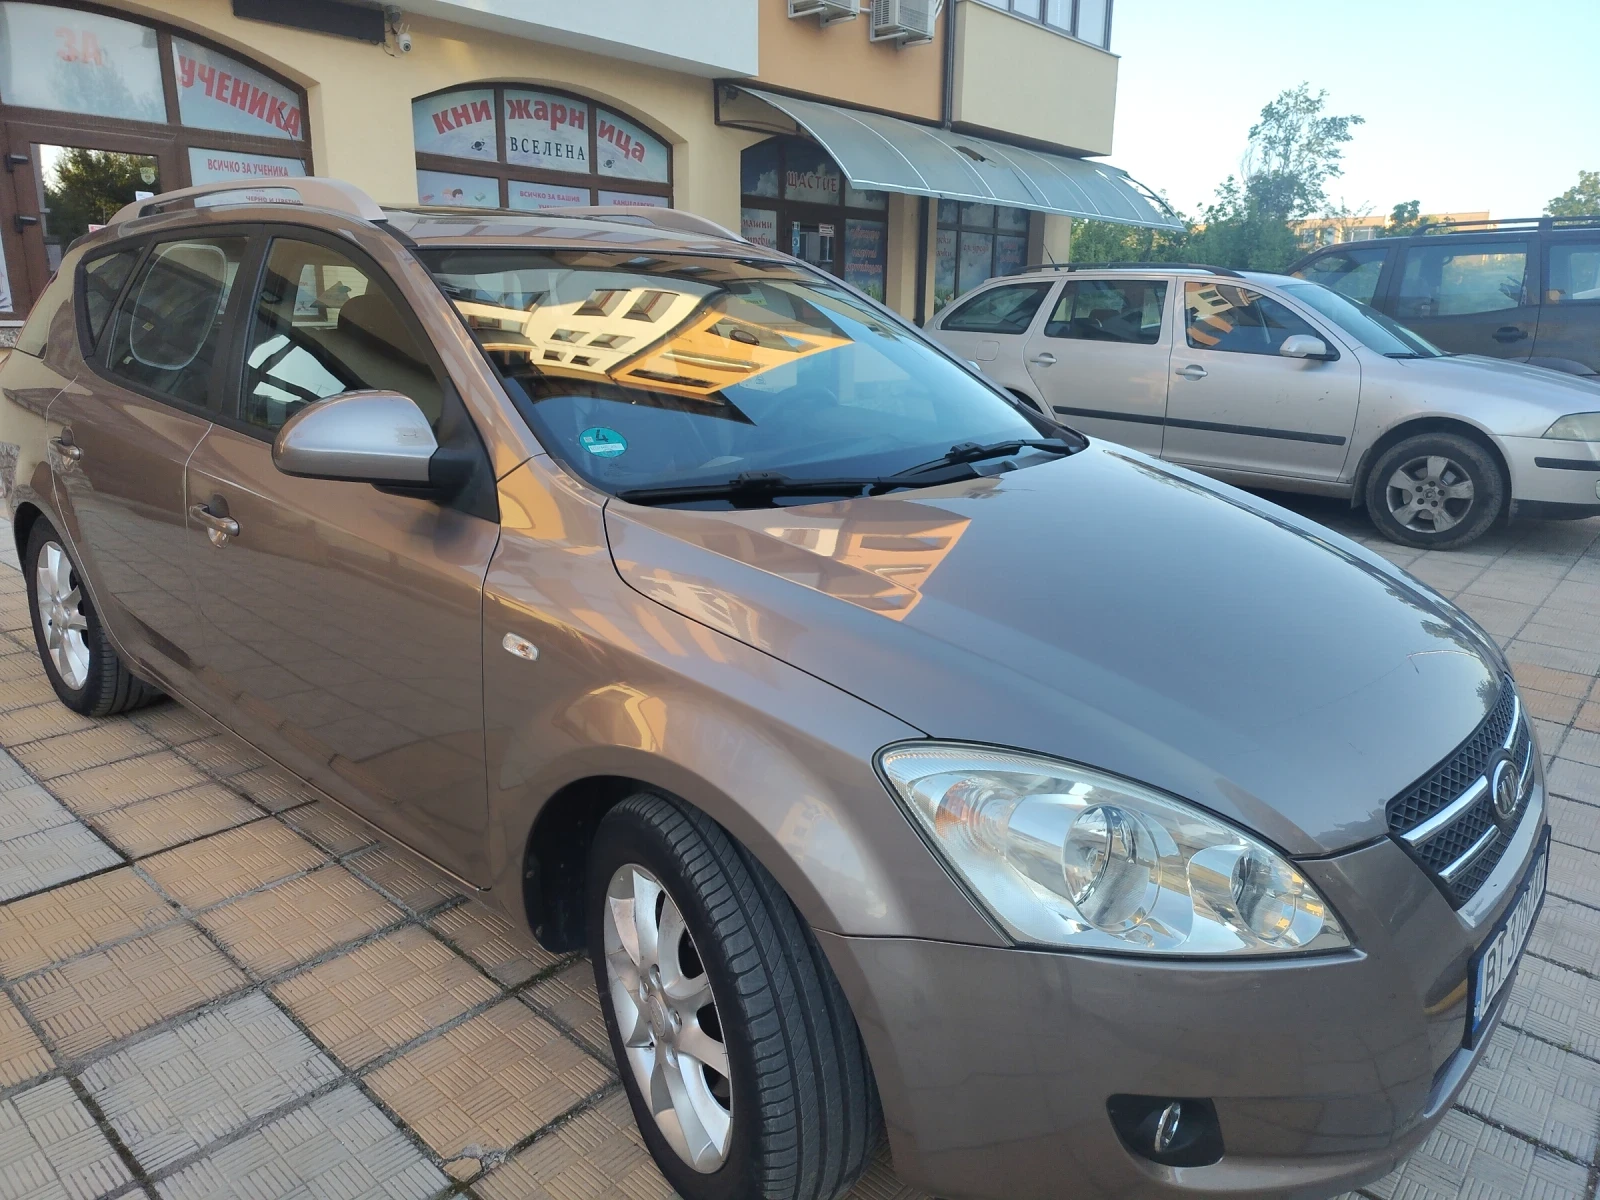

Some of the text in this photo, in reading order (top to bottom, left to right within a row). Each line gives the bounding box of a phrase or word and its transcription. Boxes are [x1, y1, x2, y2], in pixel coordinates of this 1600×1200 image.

[55, 26, 301, 137] ЗА УЧЕНИКА
[509, 136, 586, 161] ВСЕЛЕНА
[207, 158, 289, 177] ВСИЧКО ЗА УЧЕНИКА
[786, 170, 837, 192] ЩАСТИЕ
[519, 190, 546, 200] ВСИЧКО
[547, 192, 556, 201] ЗА
